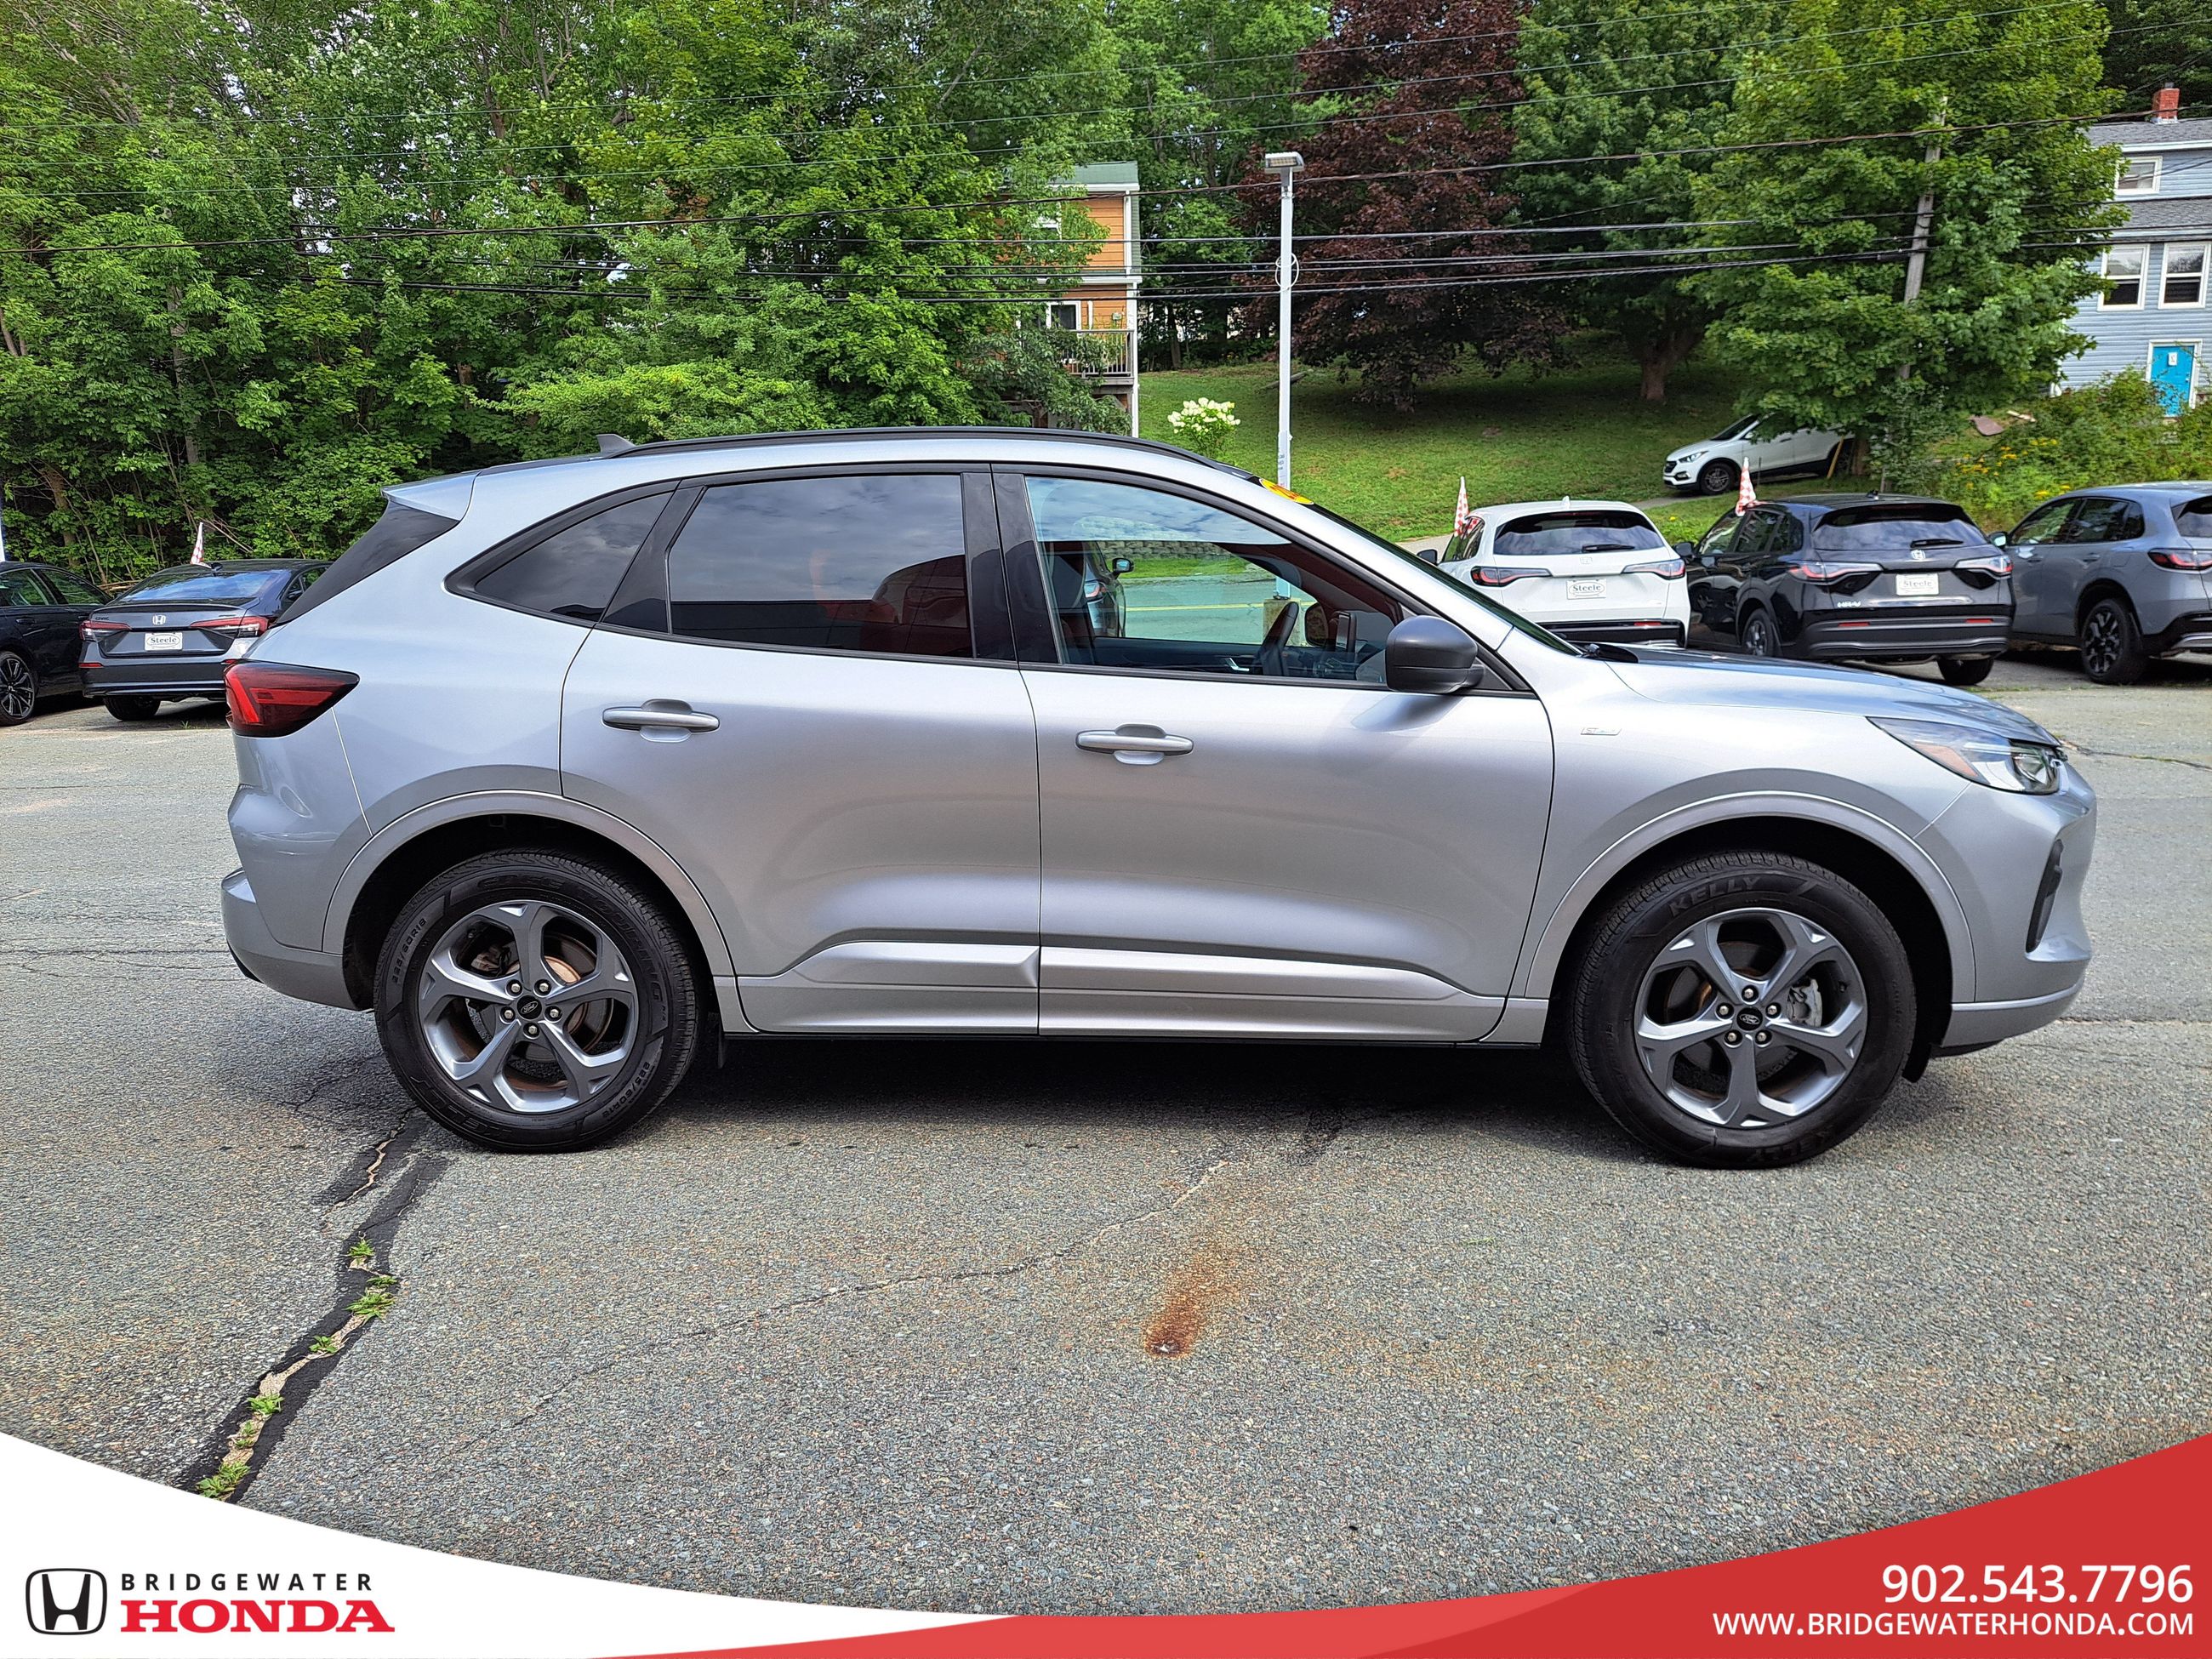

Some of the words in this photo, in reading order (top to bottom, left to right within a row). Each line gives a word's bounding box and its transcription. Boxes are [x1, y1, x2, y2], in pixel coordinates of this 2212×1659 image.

[1571, 584, 1603, 592] Steele
[1902, 579, 1933, 588] Steele
[151, 636, 177, 644] Steele
[1668, 876, 1762, 919] KELLY
[391, 917, 428, 983] 225/60R18
